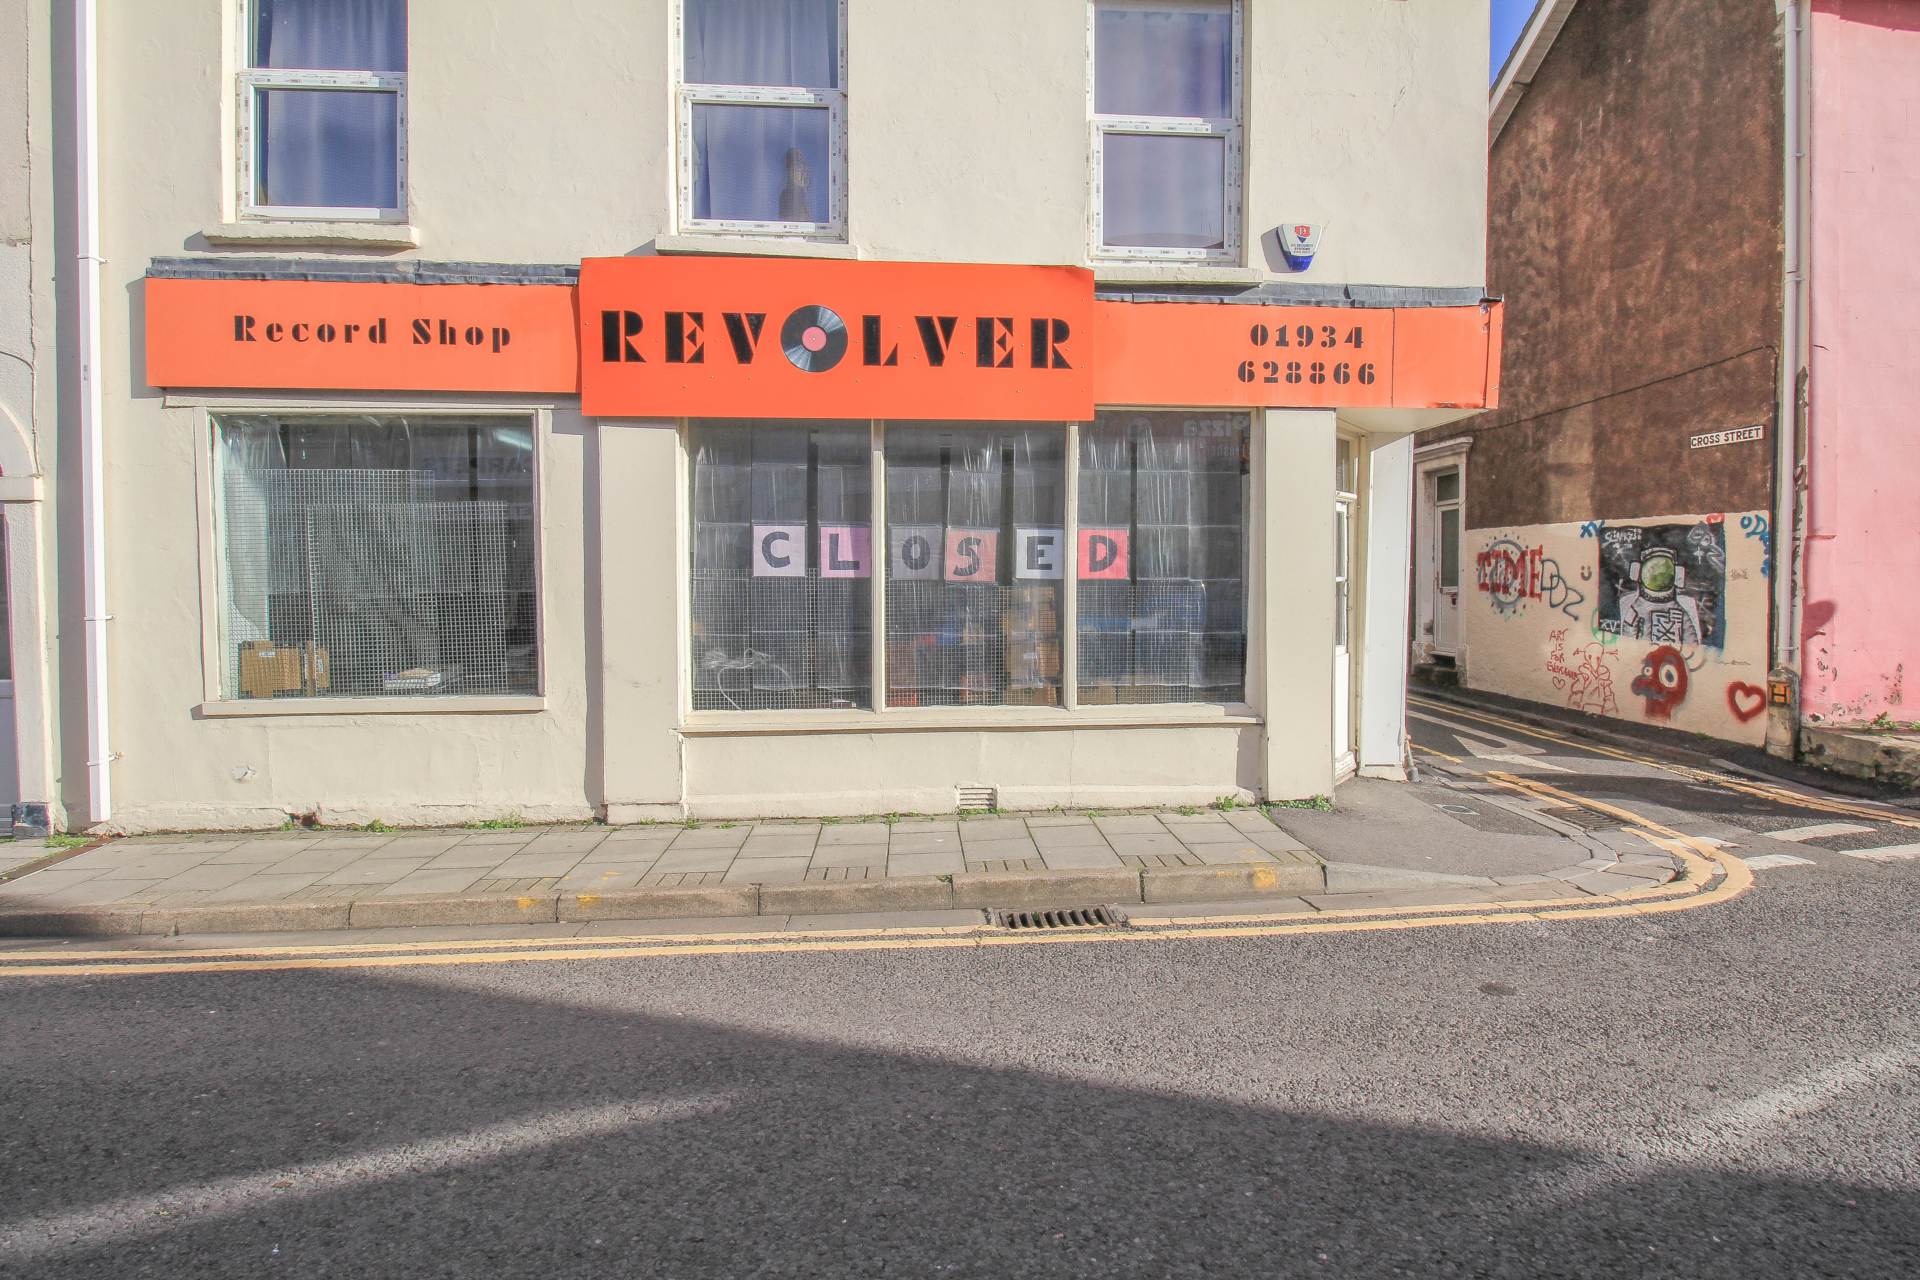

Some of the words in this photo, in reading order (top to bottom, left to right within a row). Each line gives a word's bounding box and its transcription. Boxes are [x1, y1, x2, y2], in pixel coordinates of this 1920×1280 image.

[234, 315, 387, 344] Record
[412, 318, 510, 354] Shop
[601, 304, 1073, 373] REVOLVER
[1249, 324, 1364, 349] 01934
[1237, 360, 1375, 385] 628866
[1691, 434, 1720, 447] CROSS
[1724, 428, 1761, 442] STREET
[761, 531, 1118, 577] CLOSED
[1476, 544, 1544, 602] TIME
[1549, 628, 1568, 641] ART
[1771, 683, 1787, 704] H
